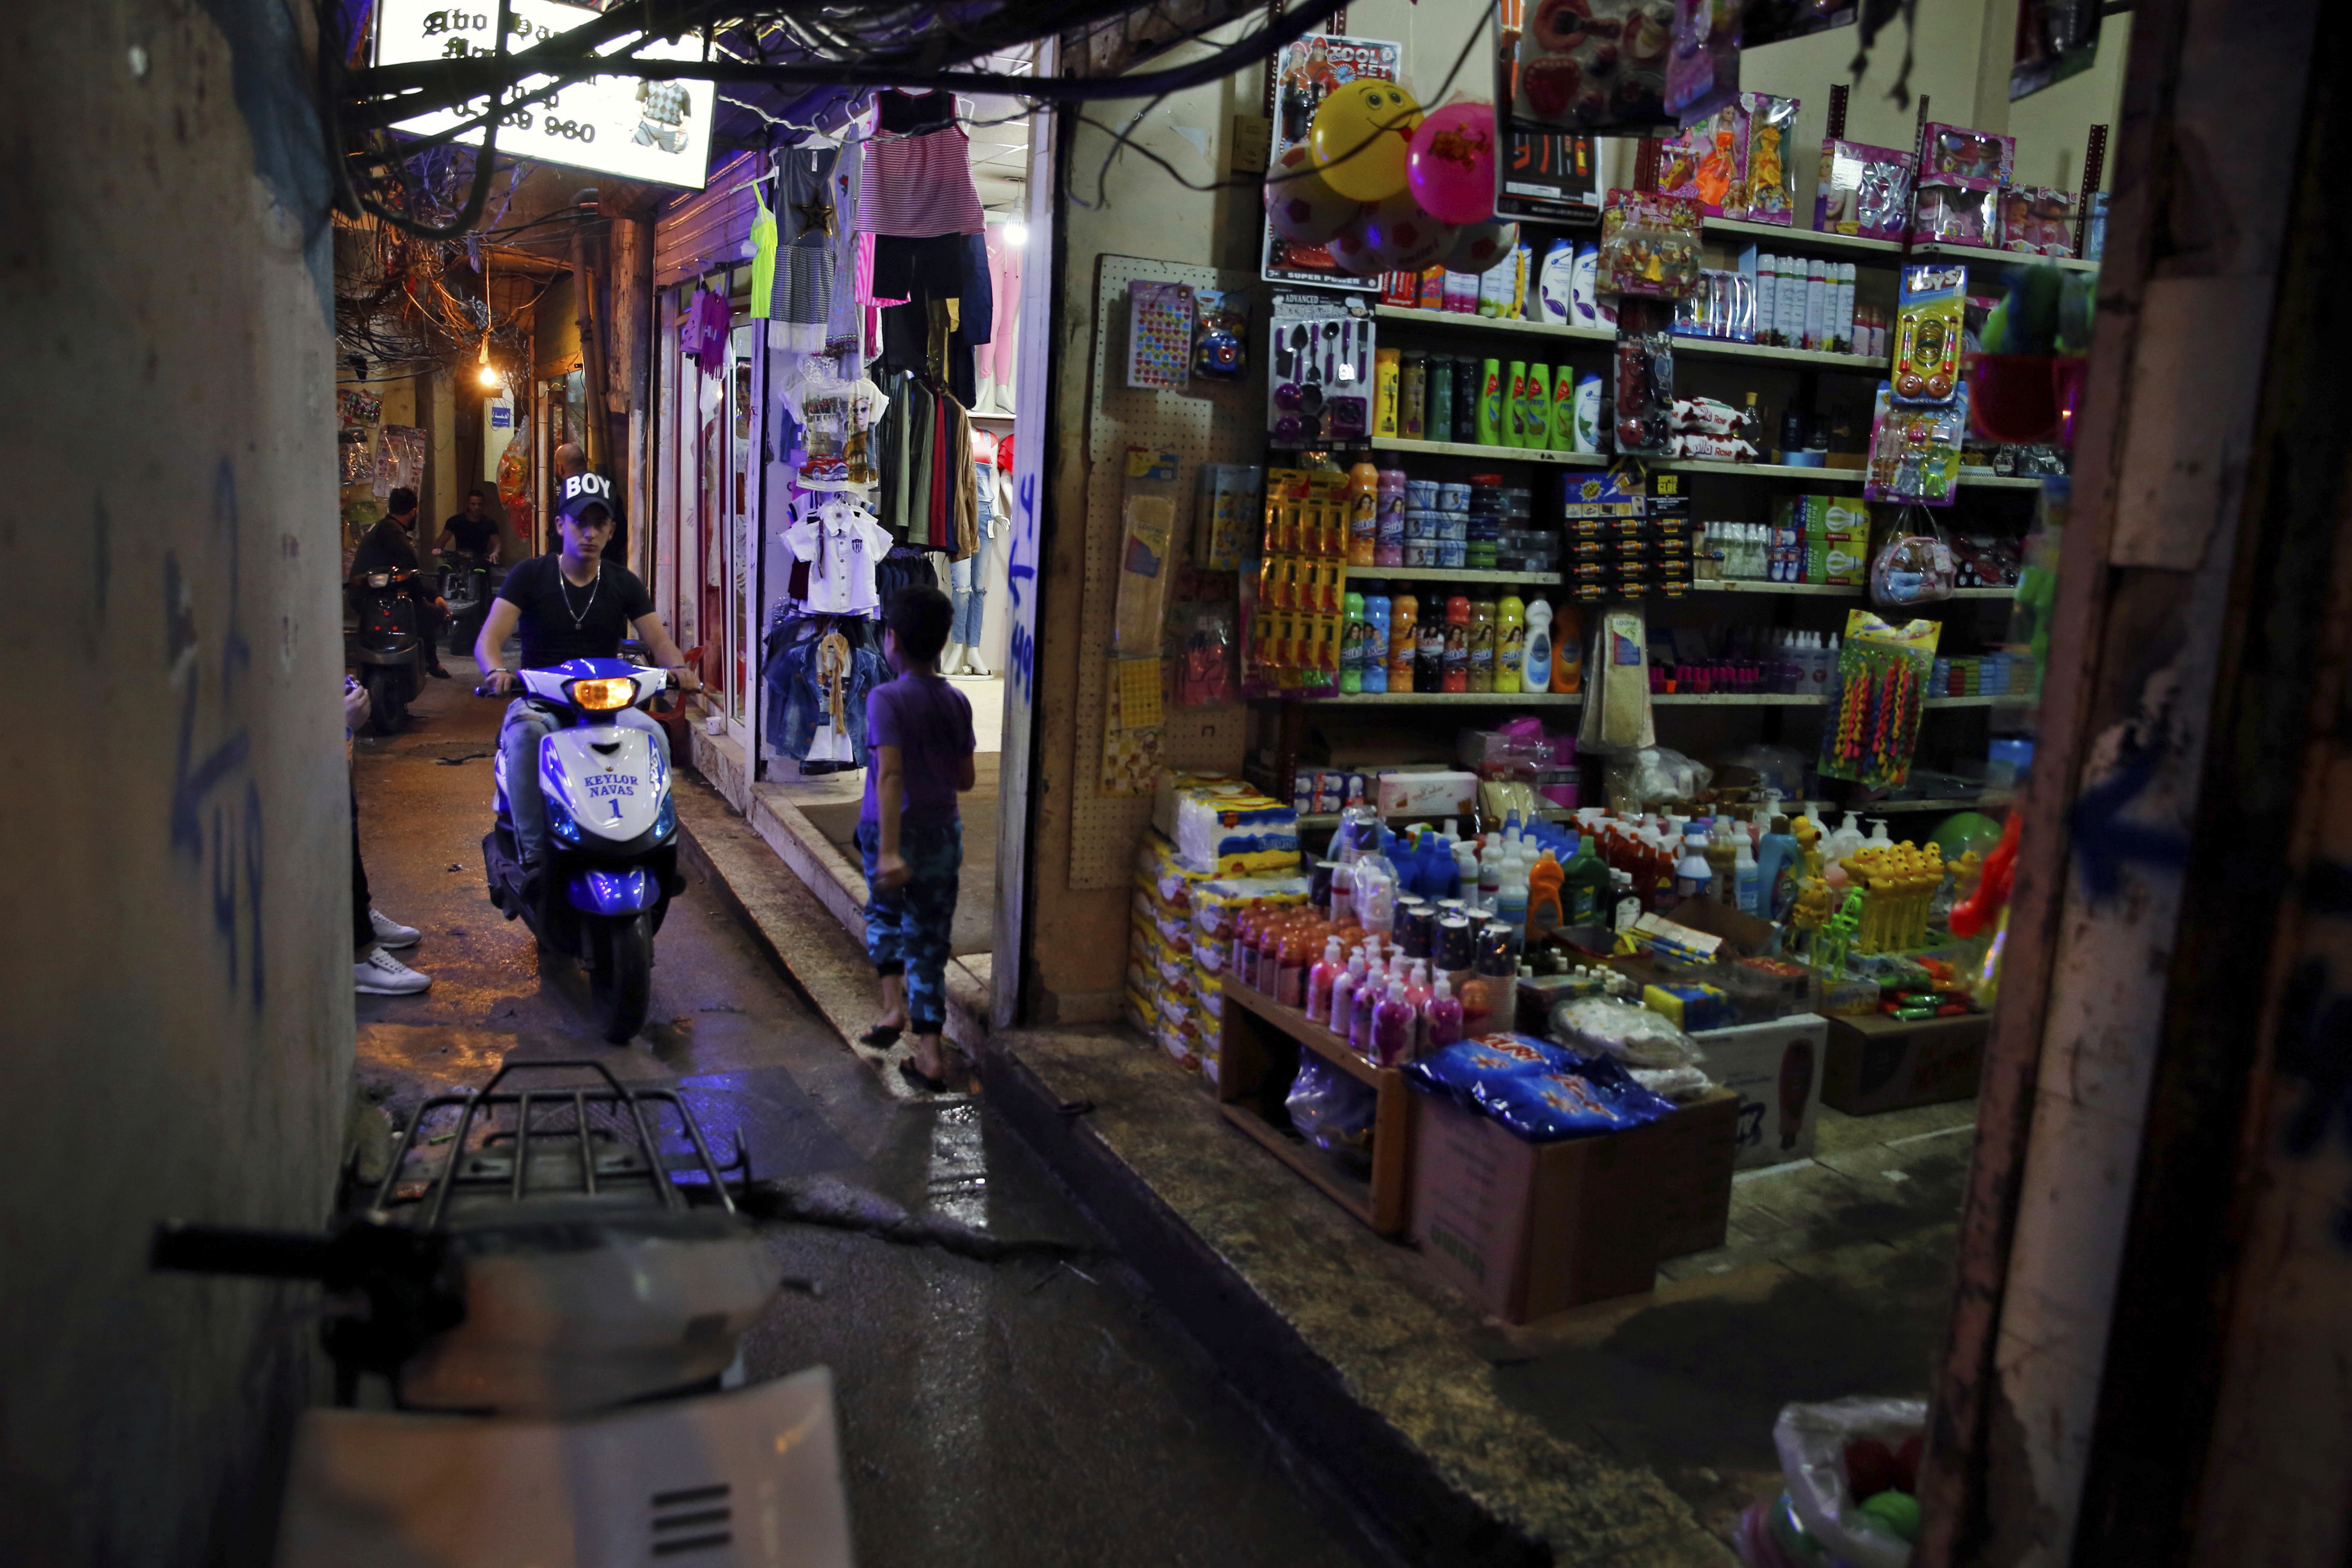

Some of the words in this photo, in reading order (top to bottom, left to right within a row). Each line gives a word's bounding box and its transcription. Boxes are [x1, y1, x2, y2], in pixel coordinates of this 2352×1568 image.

[1330, 46, 1379, 65] TOOL
[1357, 63, 1390, 77] SET
[544, 116, 596, 144] 960
[1288, 272, 1321, 281] SUPER
[1324, 276, 1360, 285] POWER
[1907, 269, 1958, 291] TOYS
[1285, 293, 1319, 304] ADVANCED
[1714, 415, 1727, 425] Rose
[1714, 447, 1733, 457] Rose
[1658, 475, 1677, 483] SUPER
[566, 472, 610, 500] BOY
[1658, 483, 1677, 494] GLUE
[584, 774, 639, 787] KEYLOR
[590, 784, 635, 798] NAVAS
[609, 798, 623, 818] 1
